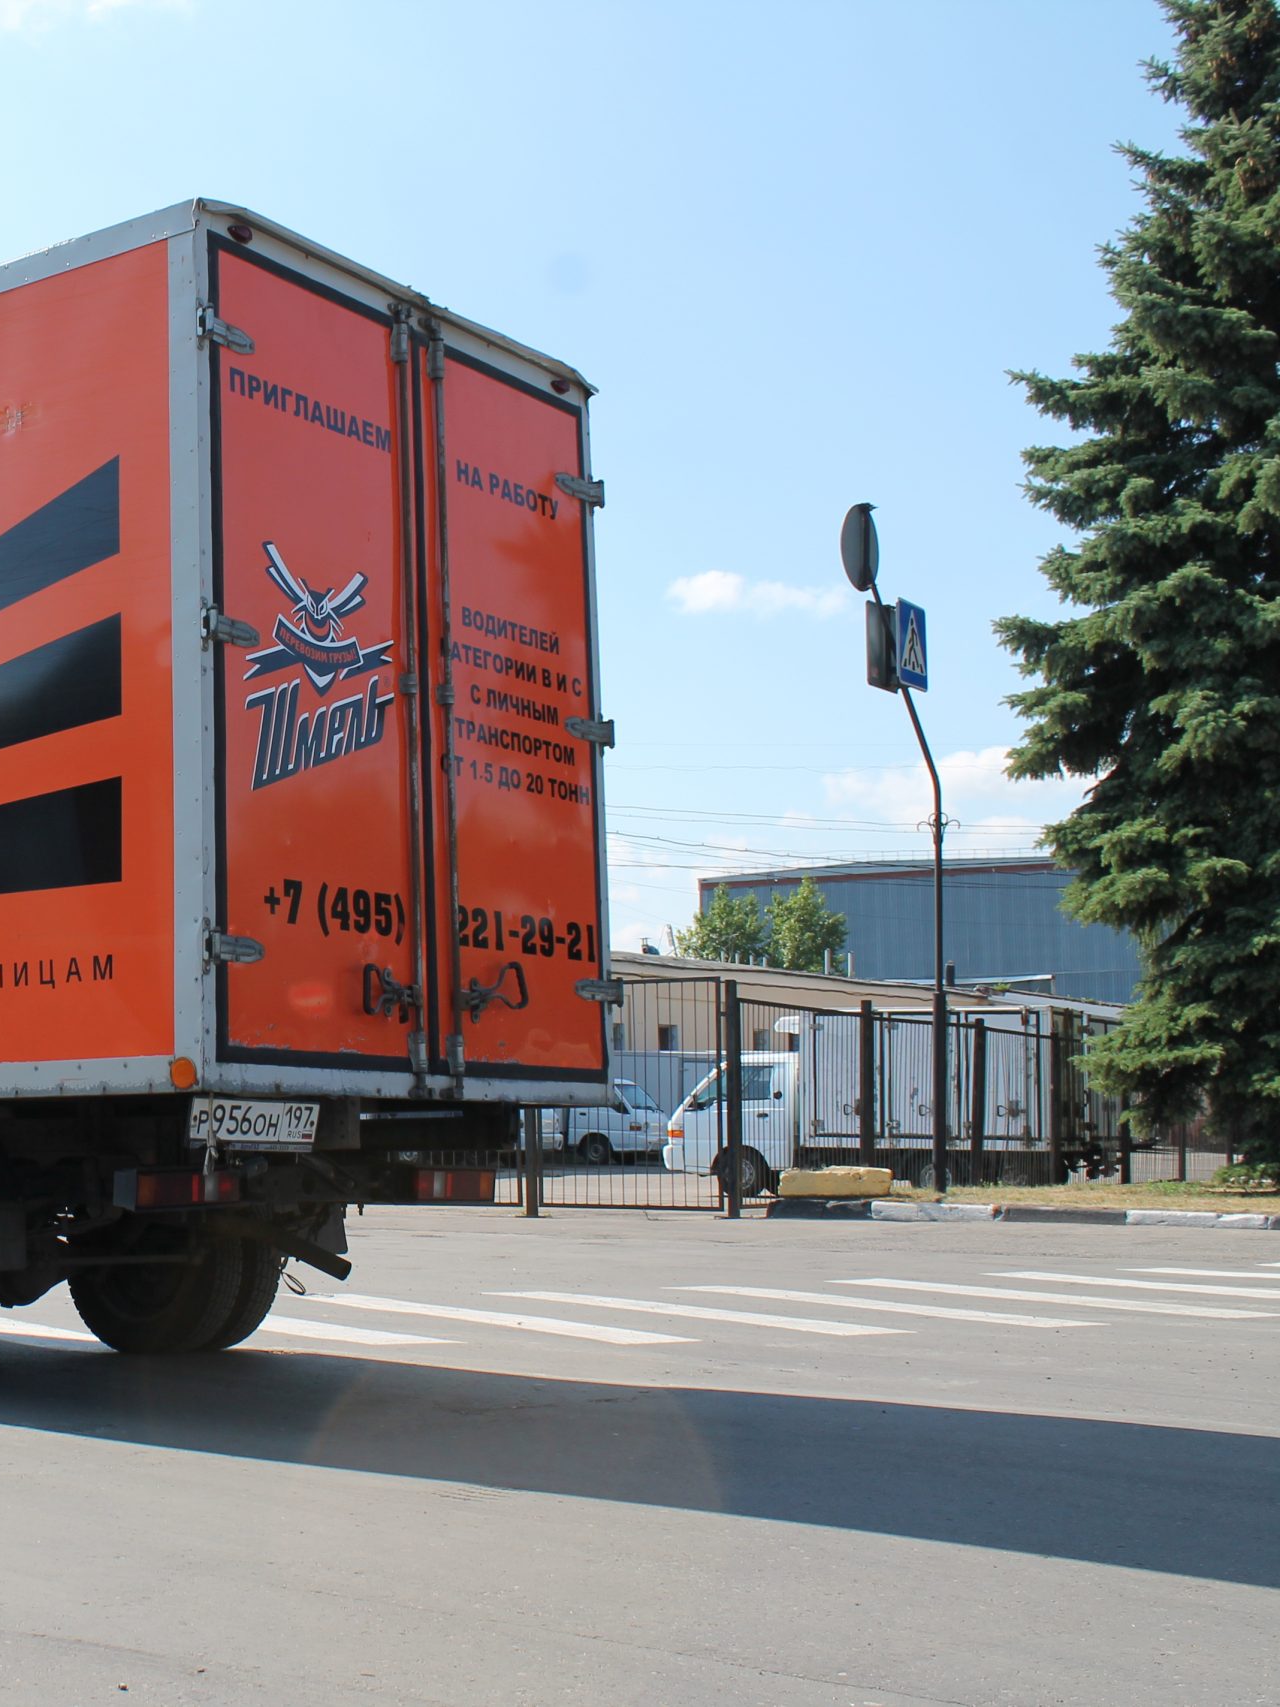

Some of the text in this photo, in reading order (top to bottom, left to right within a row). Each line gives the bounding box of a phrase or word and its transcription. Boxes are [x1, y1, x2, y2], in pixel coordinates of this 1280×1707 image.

[228, 367, 392, 454] ПРИГЛАШАЕМ
[456, 460, 559, 520] НА РАБОТУ
[280, 627, 328, 663] ПЕРЕВОЗИМ
[461, 606, 560, 655] ВОДИТЕЛЕЙ
[470, 684, 559, 726] С ЛИЧНЫМ
[542, 668, 552, 688] В
[556, 673, 567, 693] И
[572, 677, 582, 697] С
[454, 717, 575, 766] ТРАНСПОРТОМ
[470, 760, 493, 784] 1.5
[498, 766, 521, 792] ДО
[526, 772, 544, 795] 20
[548, 778, 590, 806] ТОНН
[264, 878, 597, 963] +7 (495) 221-29-21
[285, 1105, 314, 1128] 197
[287, 1130, 301, 1139] RUS
